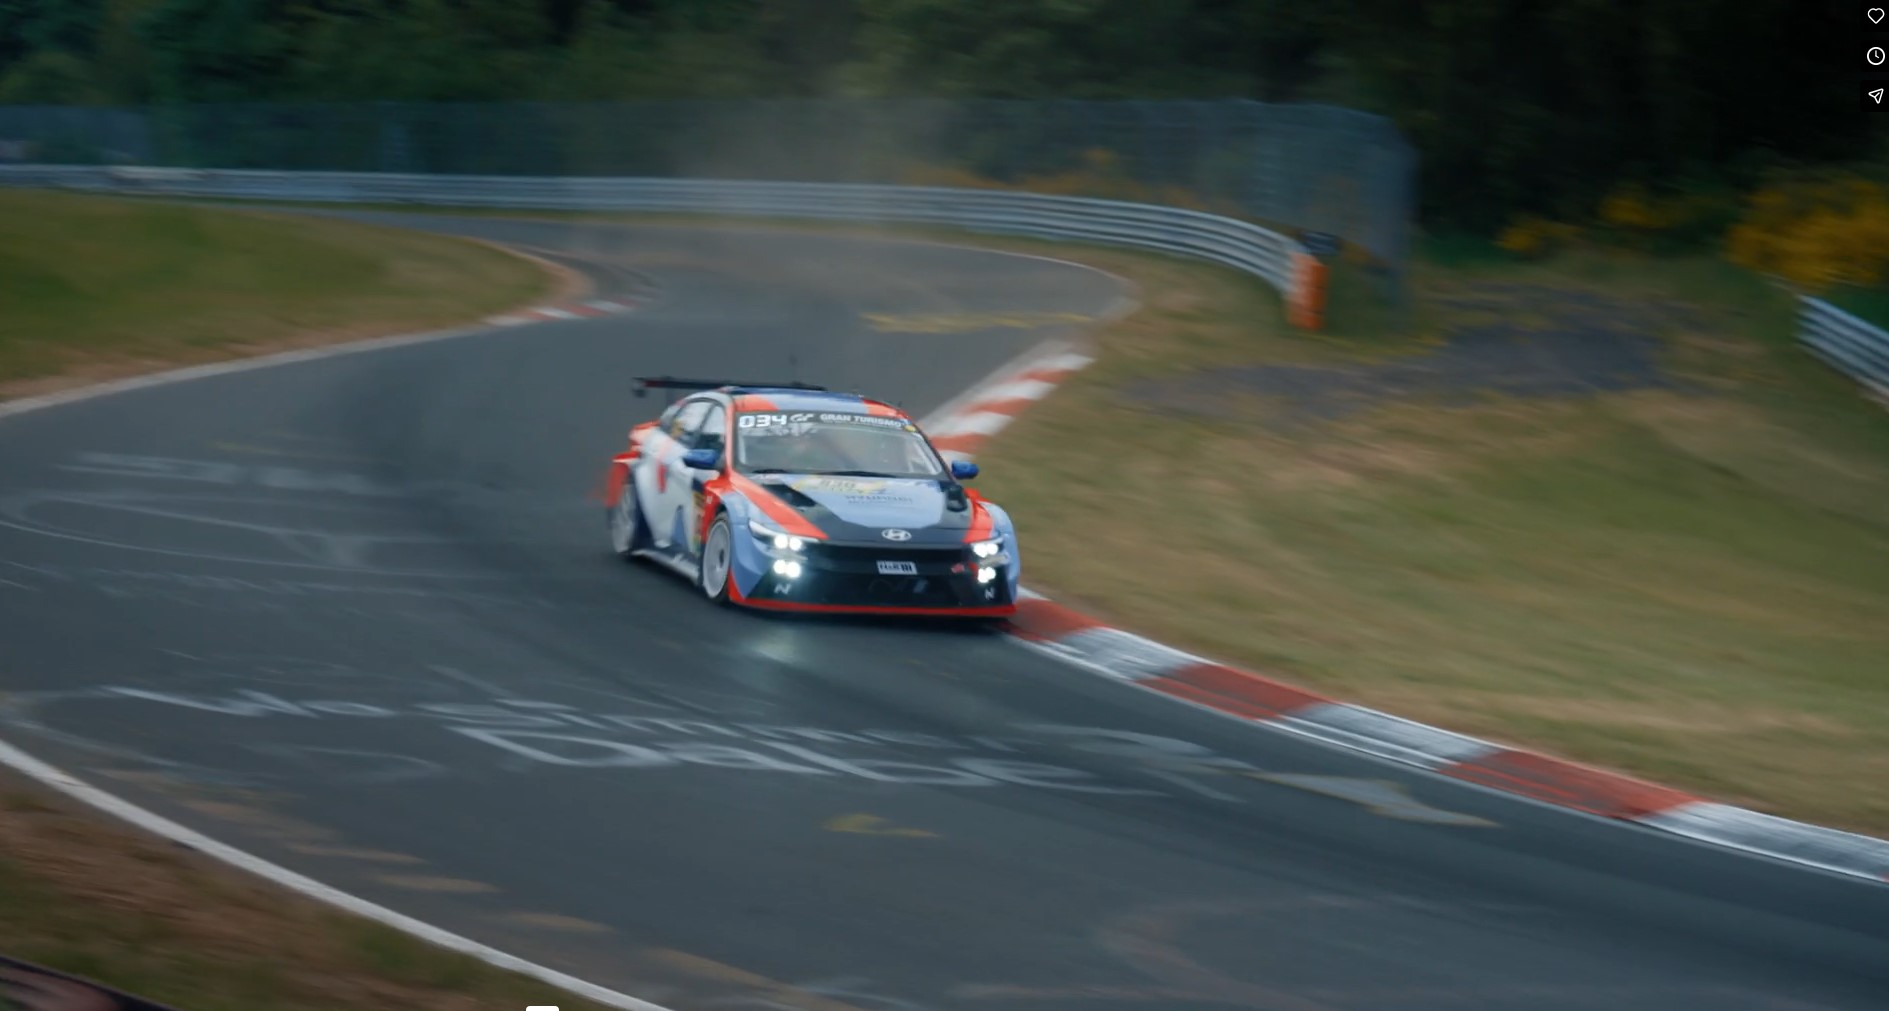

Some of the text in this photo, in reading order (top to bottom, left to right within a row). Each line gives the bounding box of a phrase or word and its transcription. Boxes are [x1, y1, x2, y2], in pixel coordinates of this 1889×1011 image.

[739, 414, 788, 428] 034
[820, 413, 850, 422] GRAN
[854, 416, 904, 428] TURISMO
